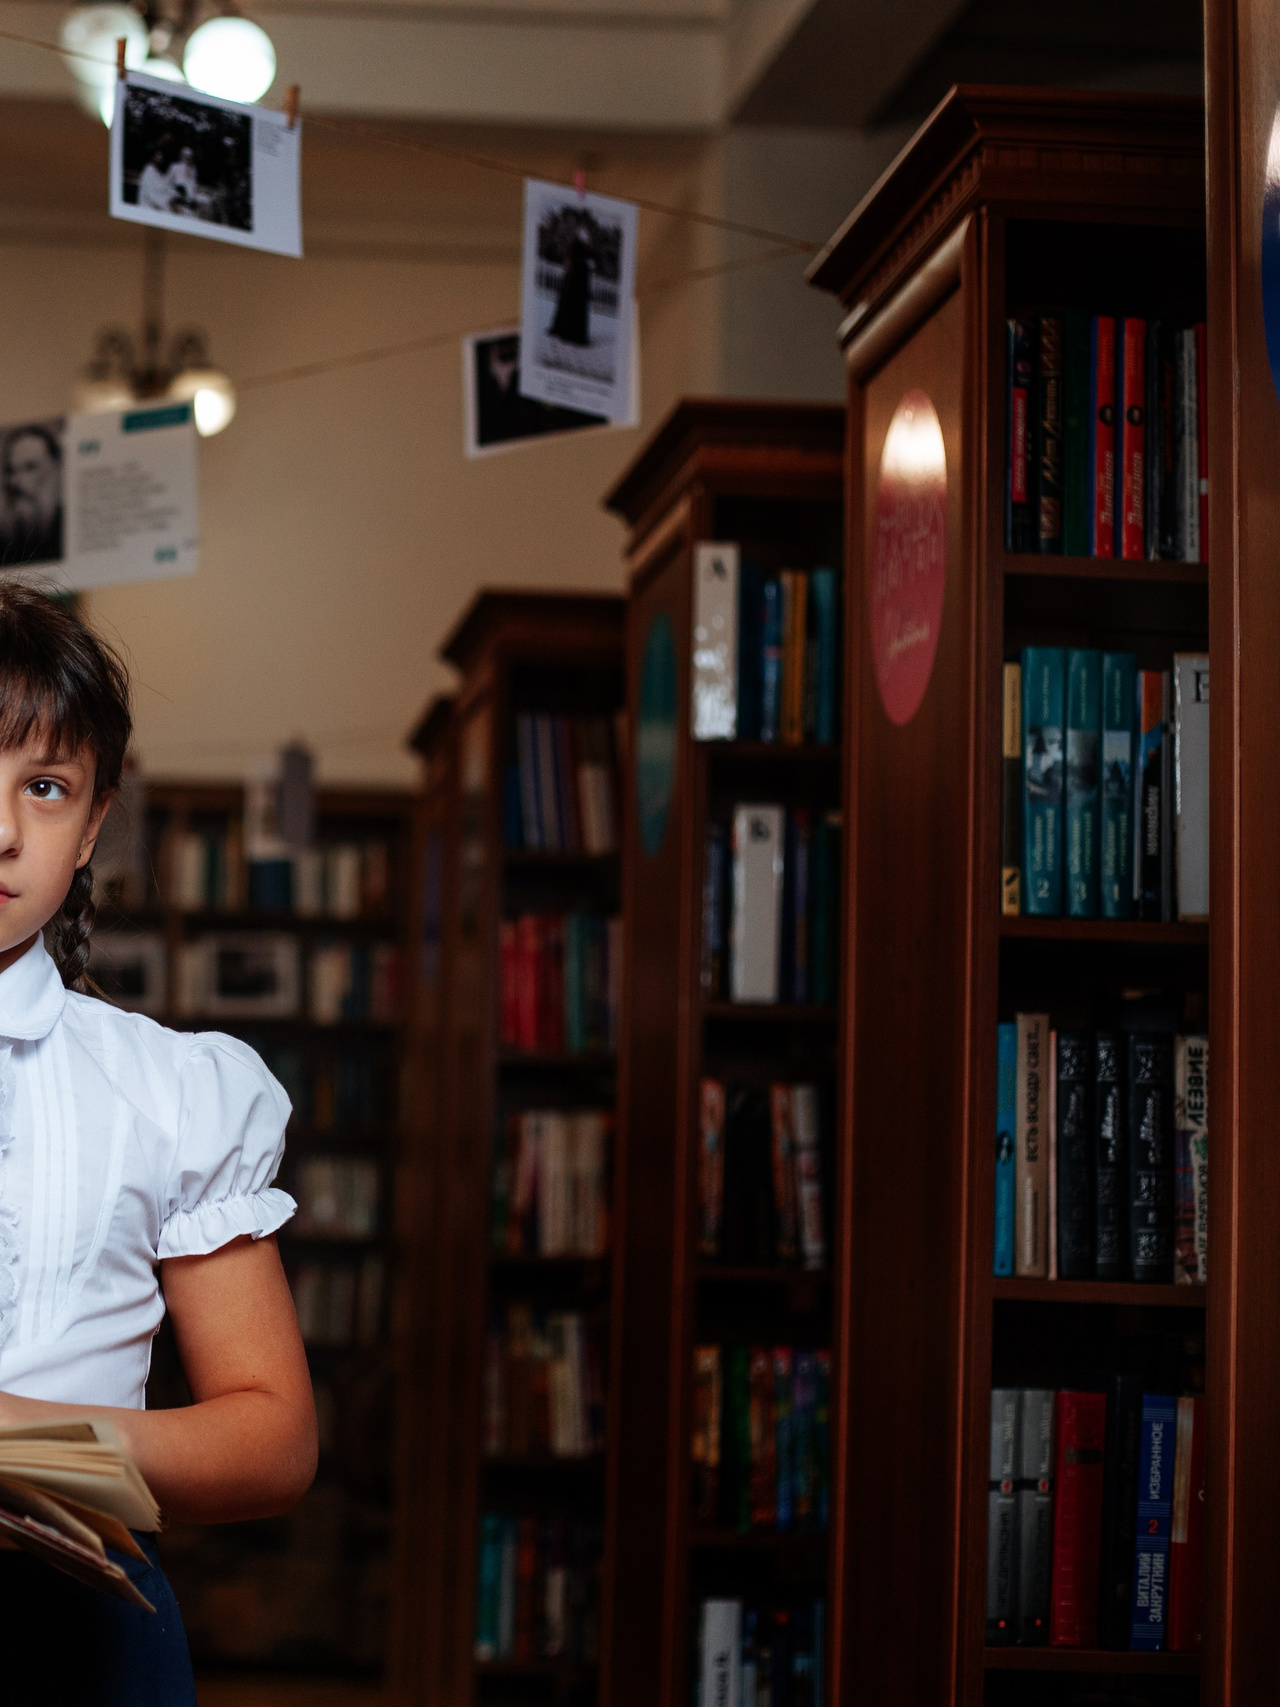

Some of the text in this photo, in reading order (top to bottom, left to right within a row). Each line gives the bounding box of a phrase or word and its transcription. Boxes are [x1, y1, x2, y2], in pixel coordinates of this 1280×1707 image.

[1026, 1071, 1041, 1124] ВСЮДУ
[1187, 1045, 1205, 1128] ЛЕЗВИЕ
[1026, 1126, 1040, 1163] ЕСТЬ
[1149, 1420, 1165, 1501] ИЗБРАННОЕ
[1147, 1518, 1159, 1534] 2
[1137, 1552, 1151, 1608] ВИТАЛИЙ
[1150, 1552, 1166, 1623] ЗАКРУТКИН
